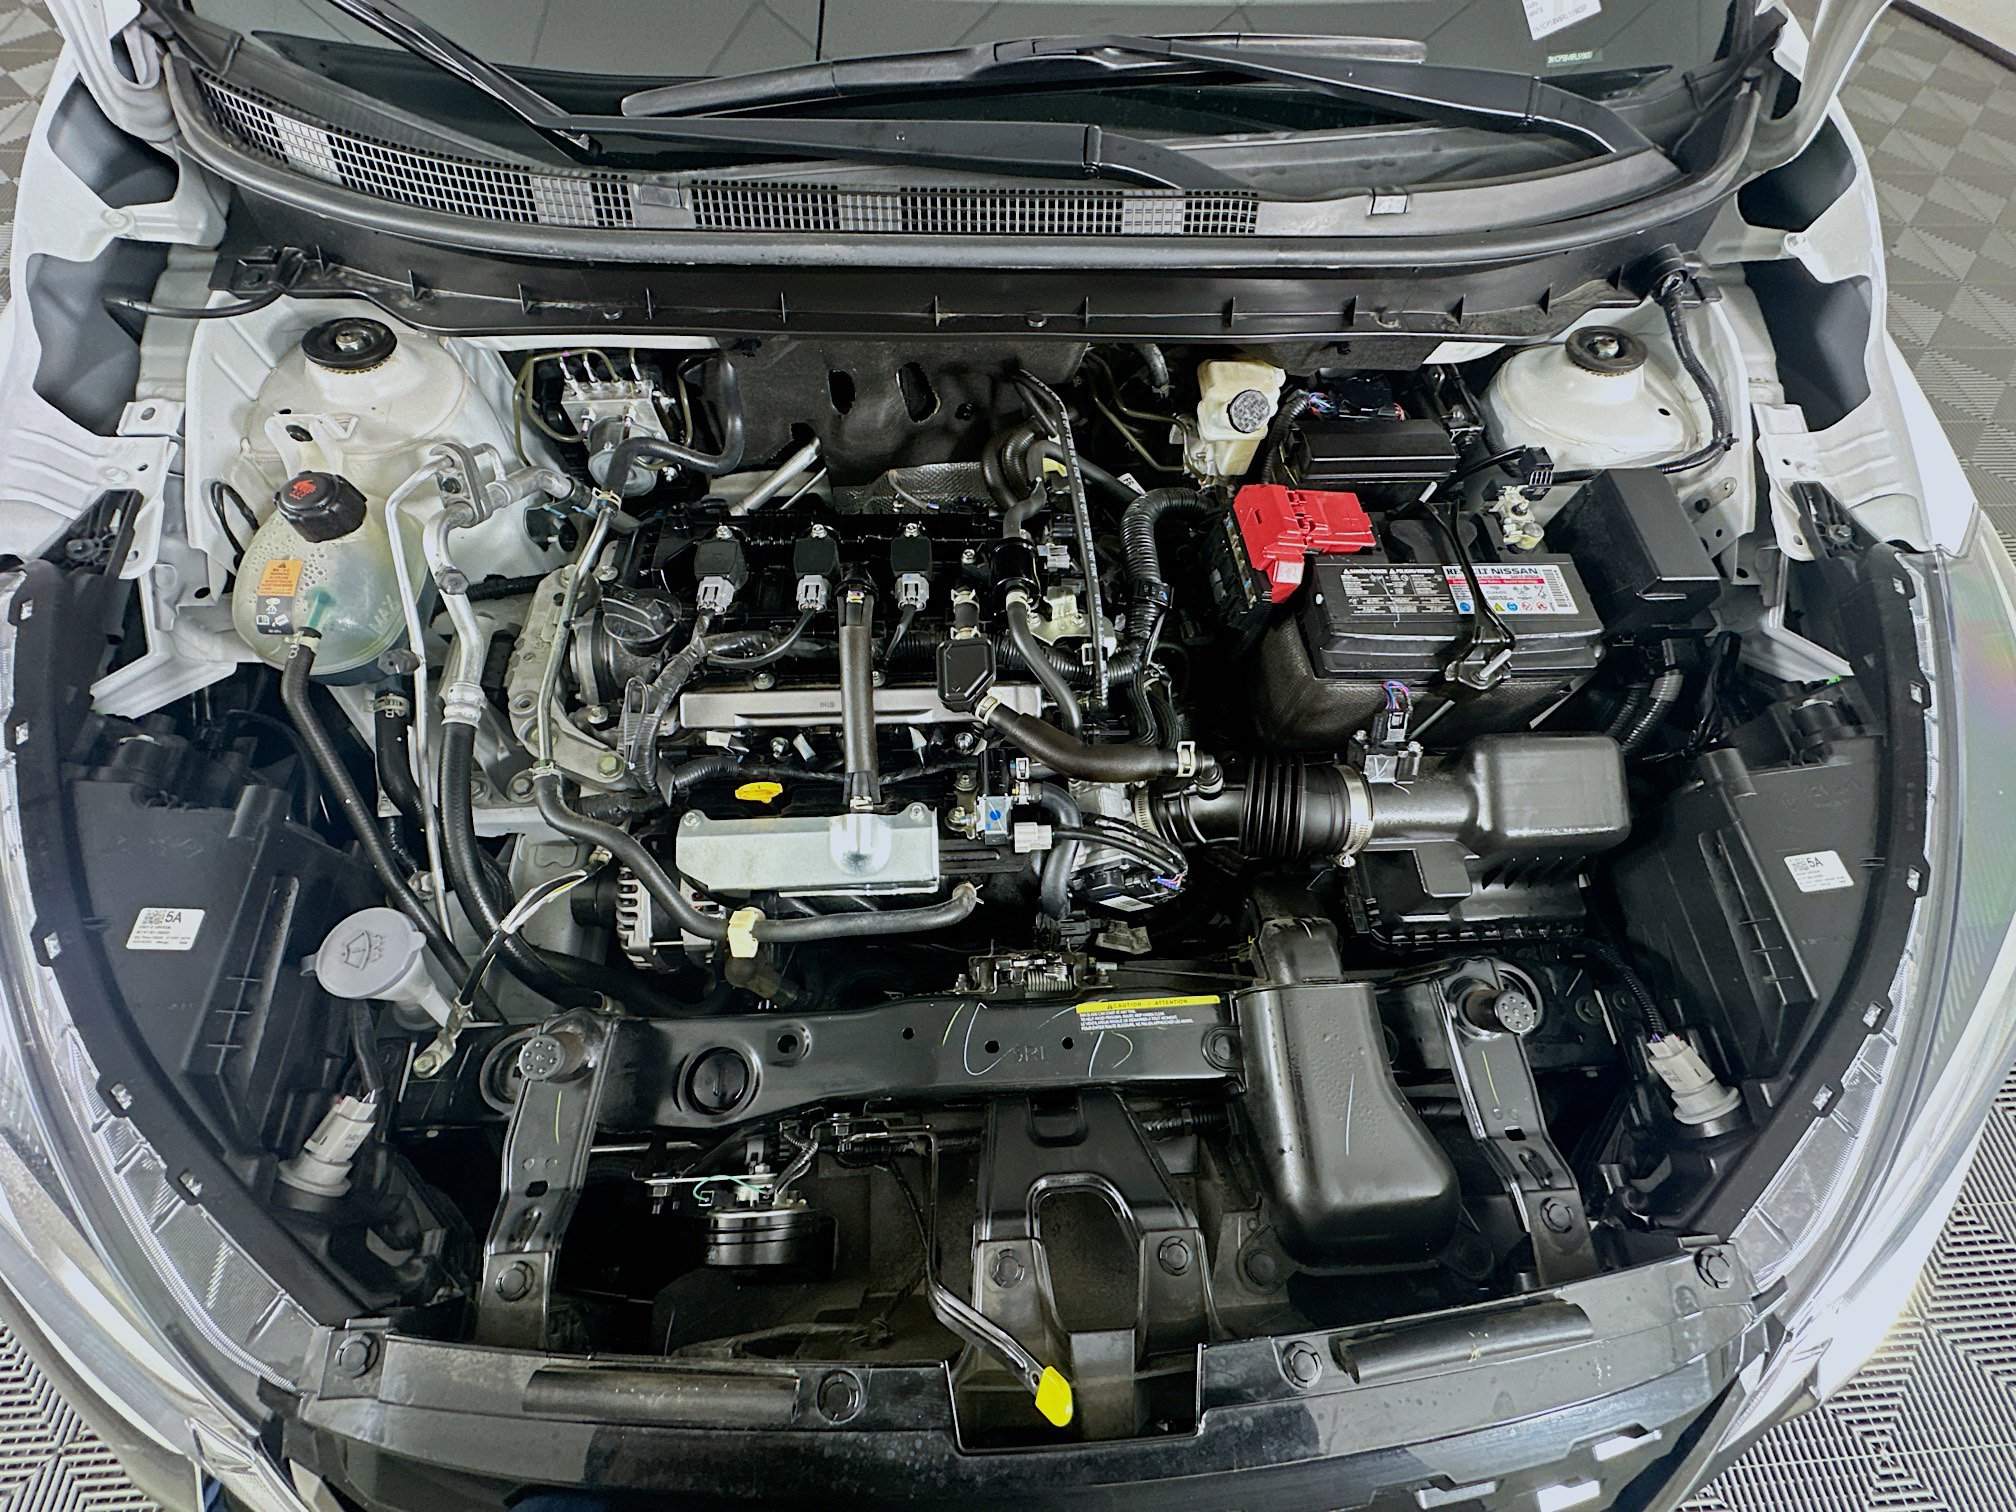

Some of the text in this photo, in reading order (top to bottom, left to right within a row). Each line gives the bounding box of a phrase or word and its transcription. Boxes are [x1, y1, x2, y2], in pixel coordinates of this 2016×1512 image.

[1491, 567, 1538, 575] NISSAN
[1806, 856, 1824, 868] 5A
[165, 910, 182, 923] 5A
